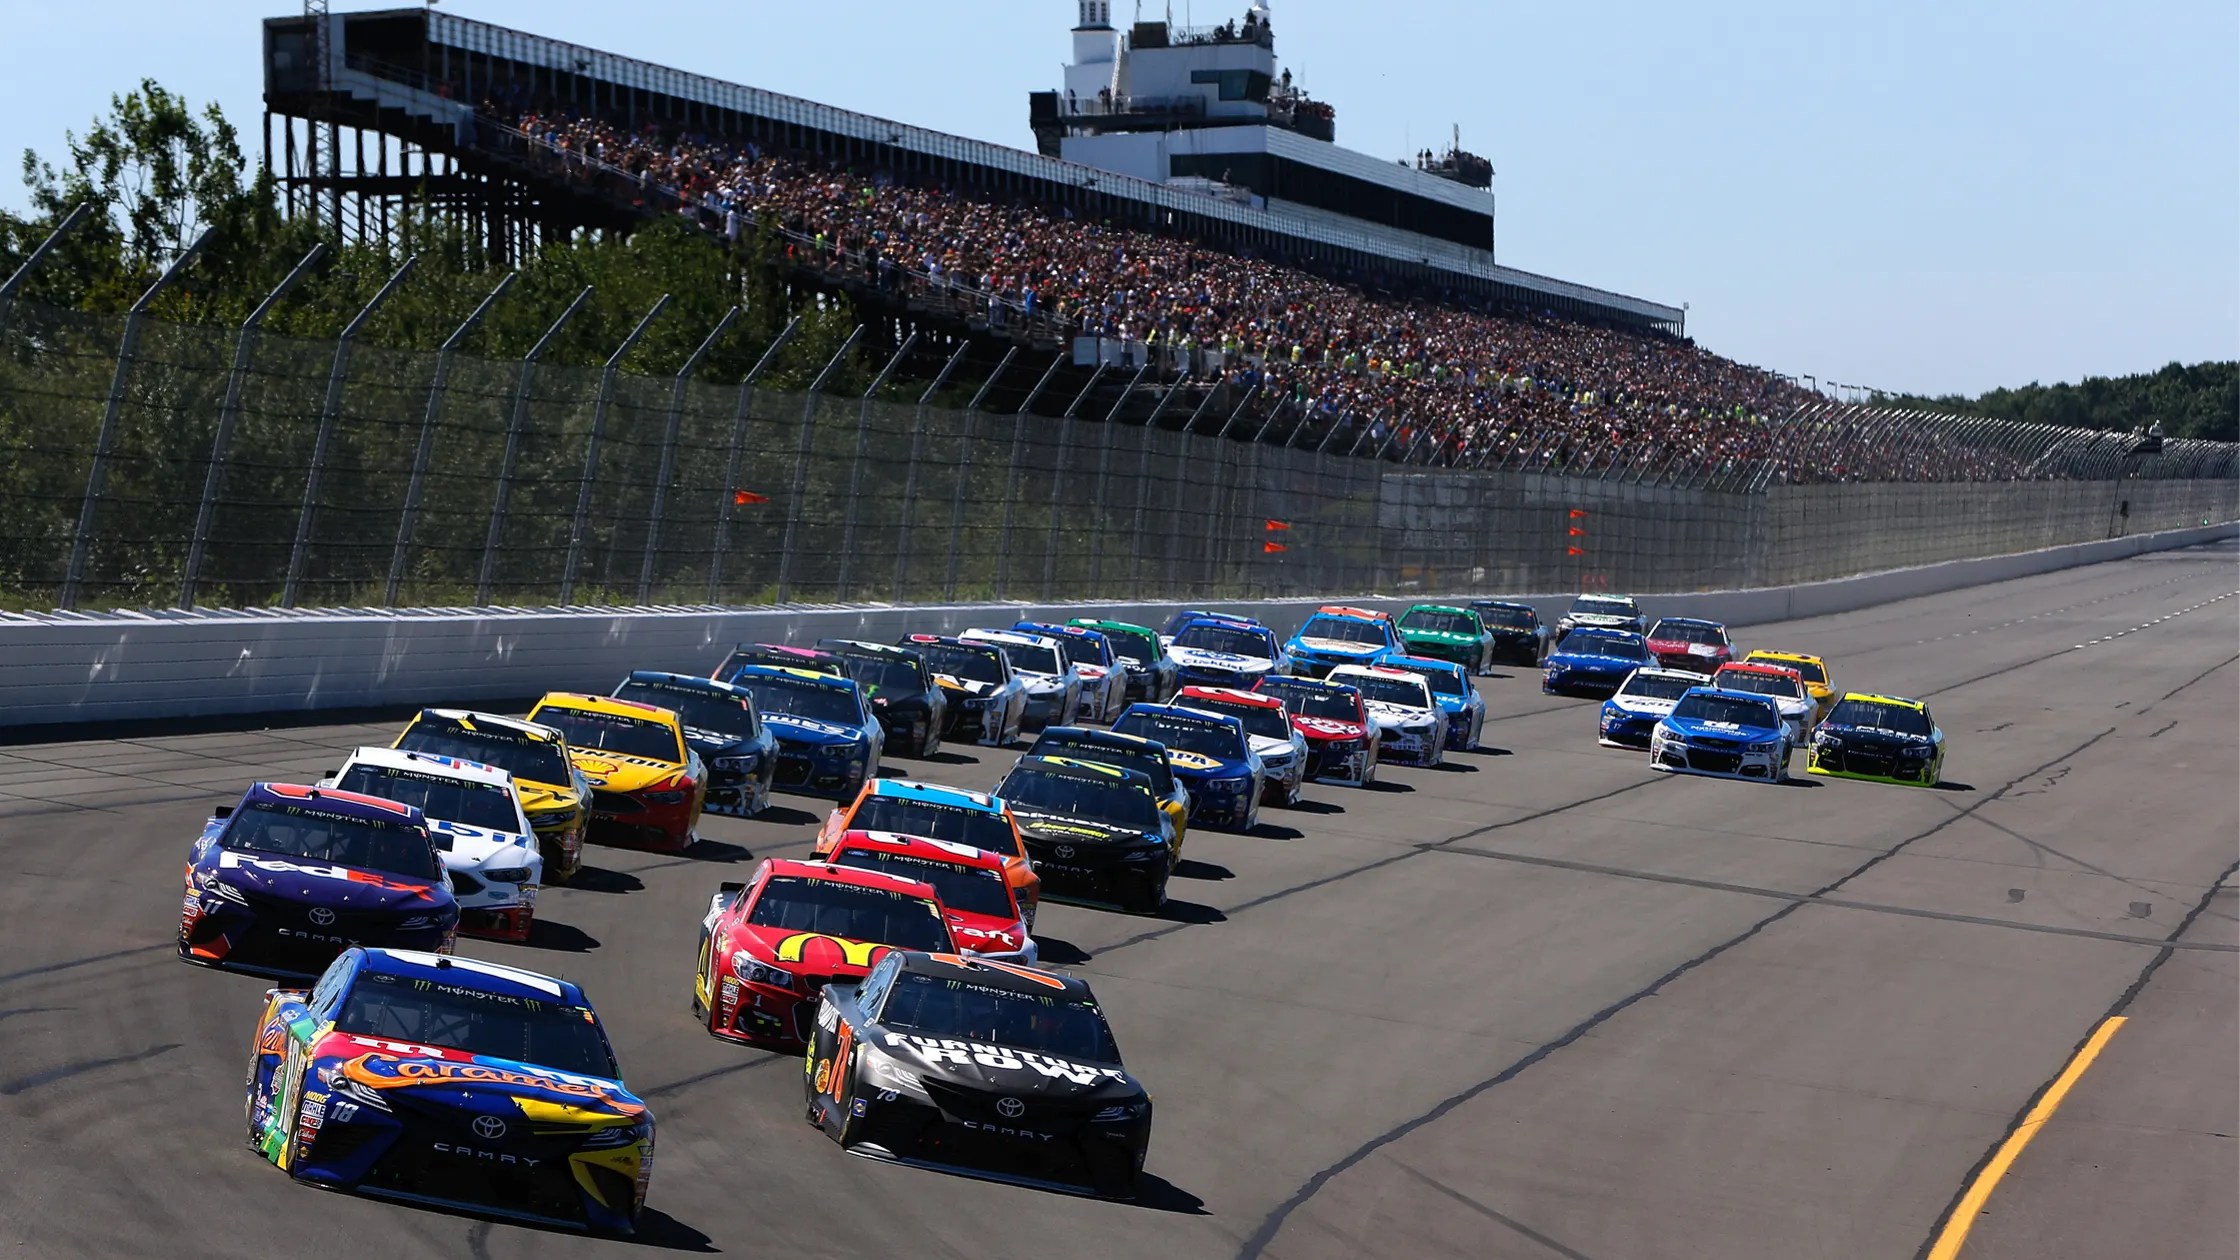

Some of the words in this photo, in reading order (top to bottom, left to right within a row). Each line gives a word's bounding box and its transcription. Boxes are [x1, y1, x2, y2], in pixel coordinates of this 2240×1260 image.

[403, 771, 460, 786] MONSTER
[304, 809, 369, 826] MONSTER
[219, 850, 437, 902] FedEx
[437, 984, 520, 1006] MONSTER
[966, 983, 1035, 1002] MONSTER
[883, 1031, 1128, 1086] FURNITURE
[913, 1045, 1103, 1087] ROW
[304, 1090, 328, 1104] MOOG
[330, 1100, 360, 1123] 18
[962, 1120, 1054, 1142] CAMRY
[433, 1142, 541, 1168] CAMRY
